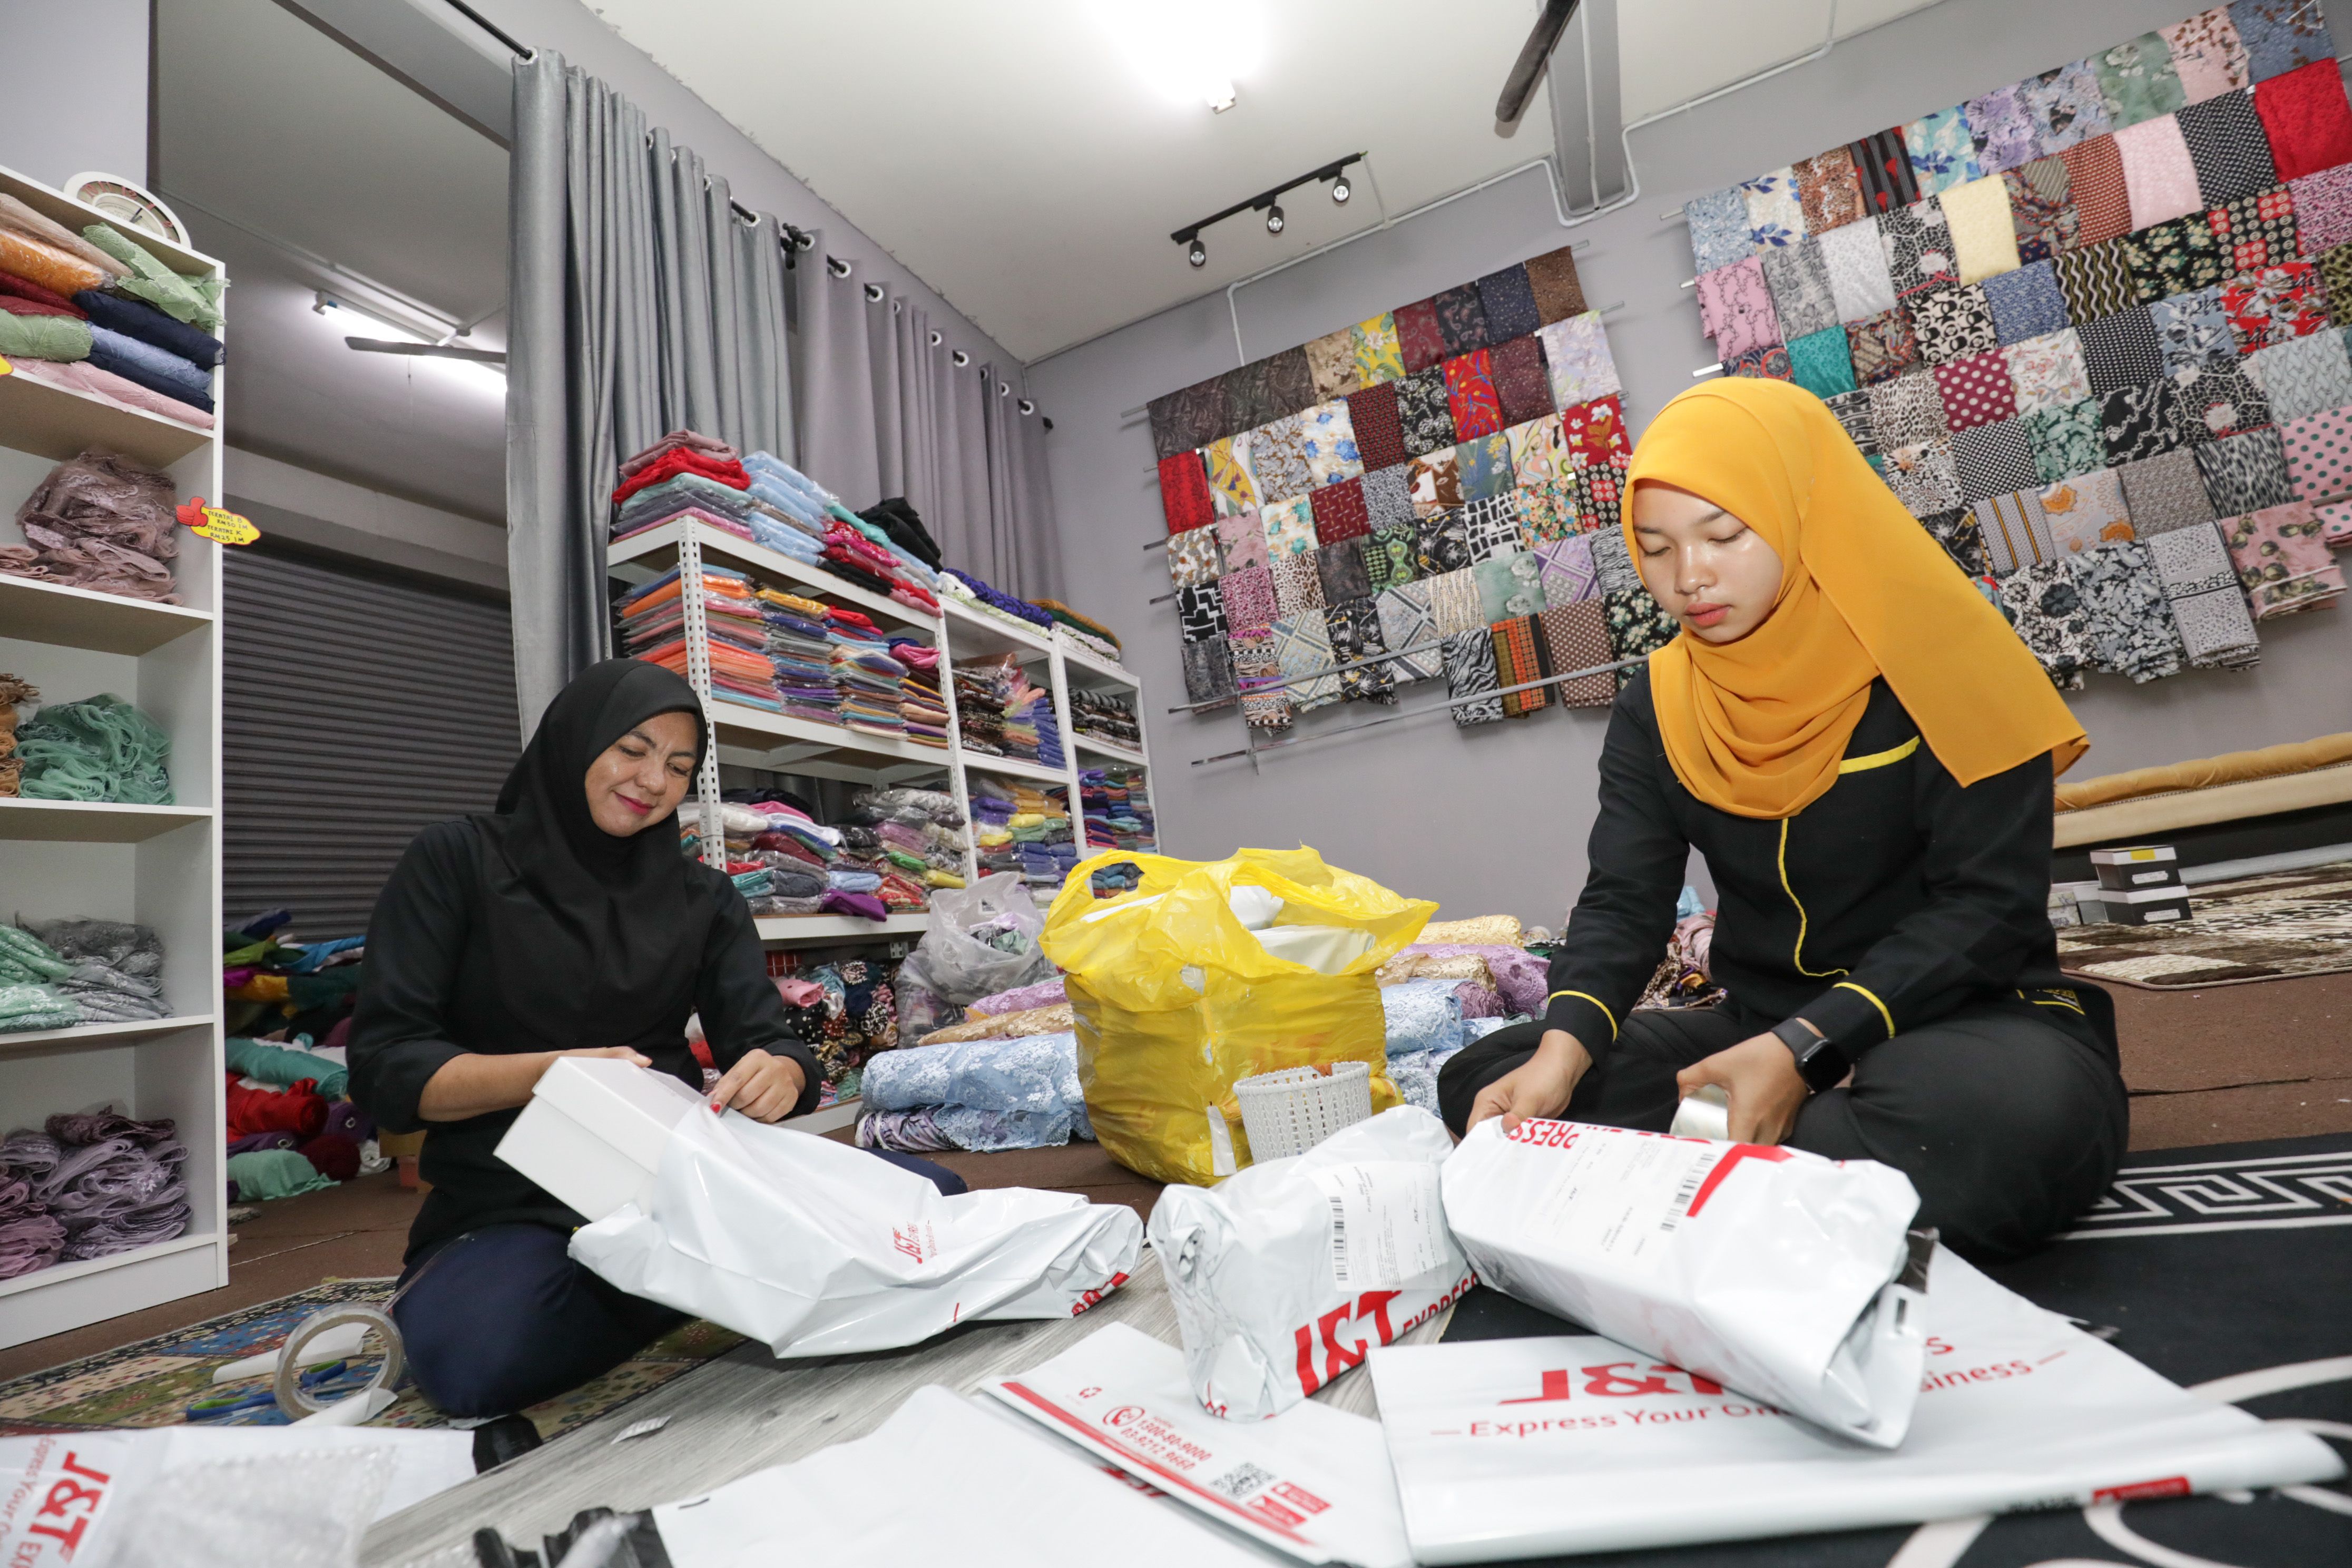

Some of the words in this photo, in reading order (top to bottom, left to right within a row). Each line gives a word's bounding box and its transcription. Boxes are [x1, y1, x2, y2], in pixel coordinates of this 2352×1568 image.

[208, 511, 233, 522] TERATAI
[217, 519, 236, 527] RM30
[208, 525, 233, 535] TERATAI
[210, 532, 230, 541] RM25
[1470, 1414, 1618, 1438] Express
[1622, 1406, 1711, 1425] Your
[28, 1450, 111, 1564] J&T
